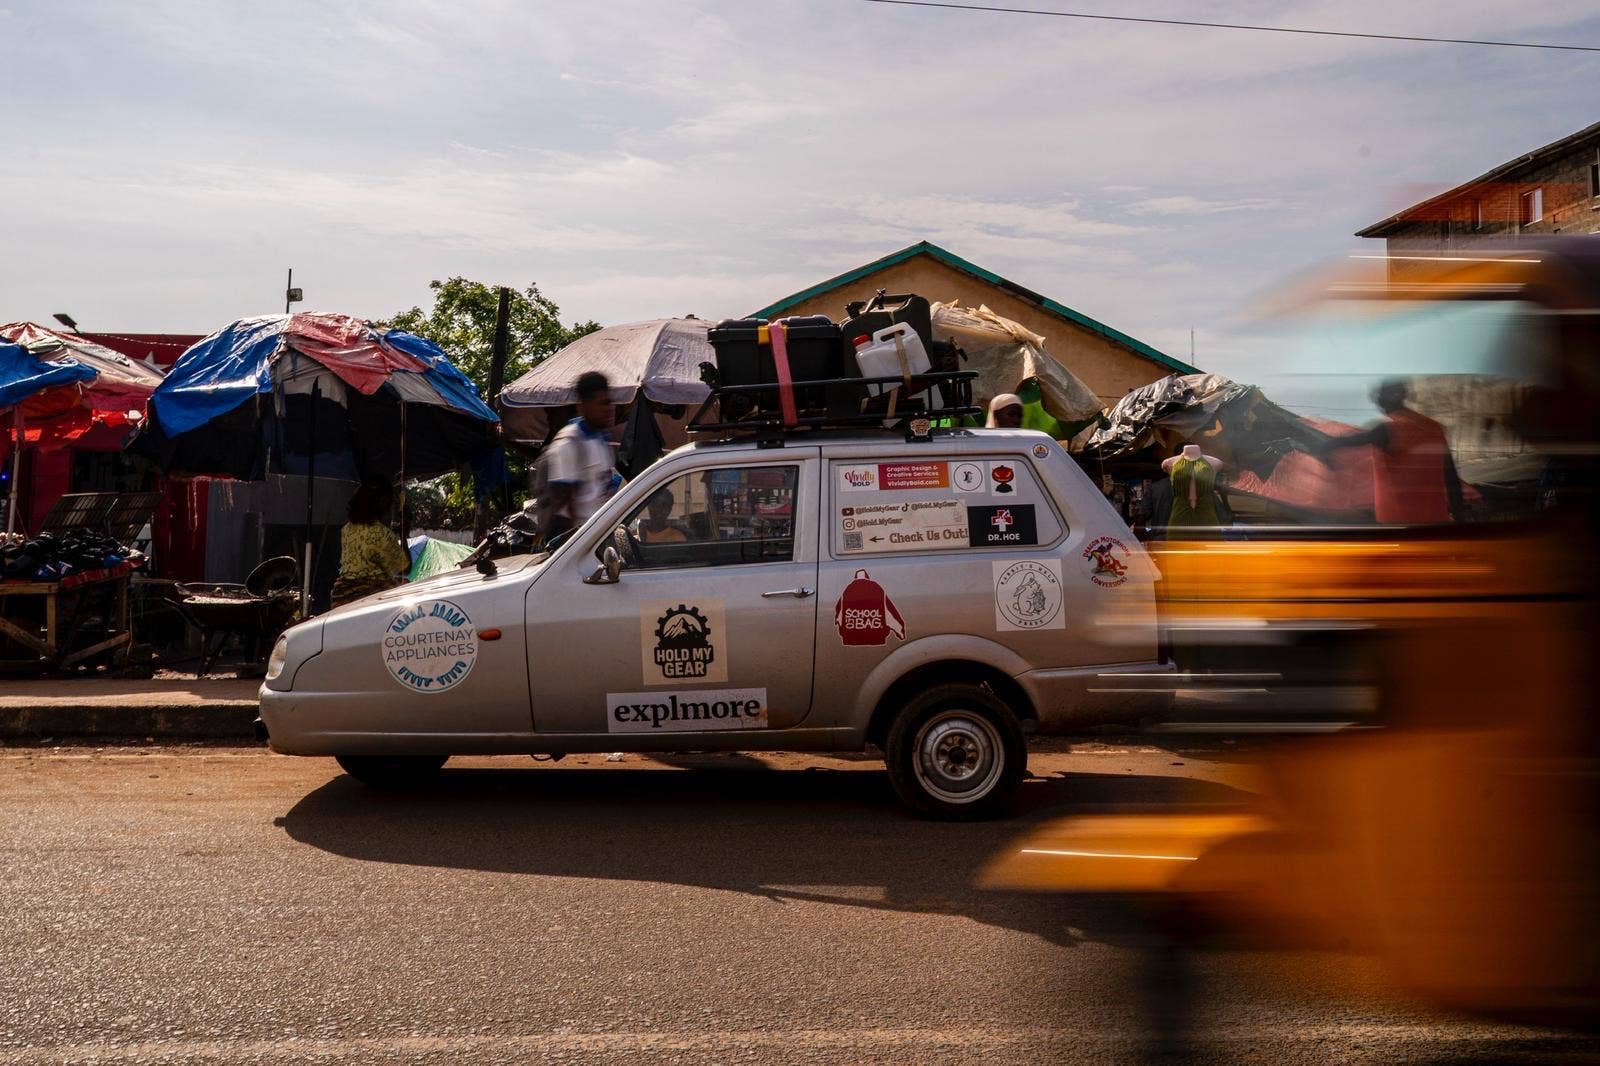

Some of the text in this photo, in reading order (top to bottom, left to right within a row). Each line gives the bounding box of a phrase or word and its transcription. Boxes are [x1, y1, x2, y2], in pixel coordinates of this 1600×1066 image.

[844, 470, 874, 483] Vividly
[889, 528, 968, 543] Check Us Out!
[1091, 576, 1128, 588] CONVERSIONS
[845, 608, 882, 618] SCHOOL
[385, 629, 474, 648] COURTENAY
[386, 643, 474, 663] APPLIANCES
[656, 648, 712, 662] HOLD MY
[664, 662, 704, 676] GEAR
[614, 695, 760, 728] explmore
